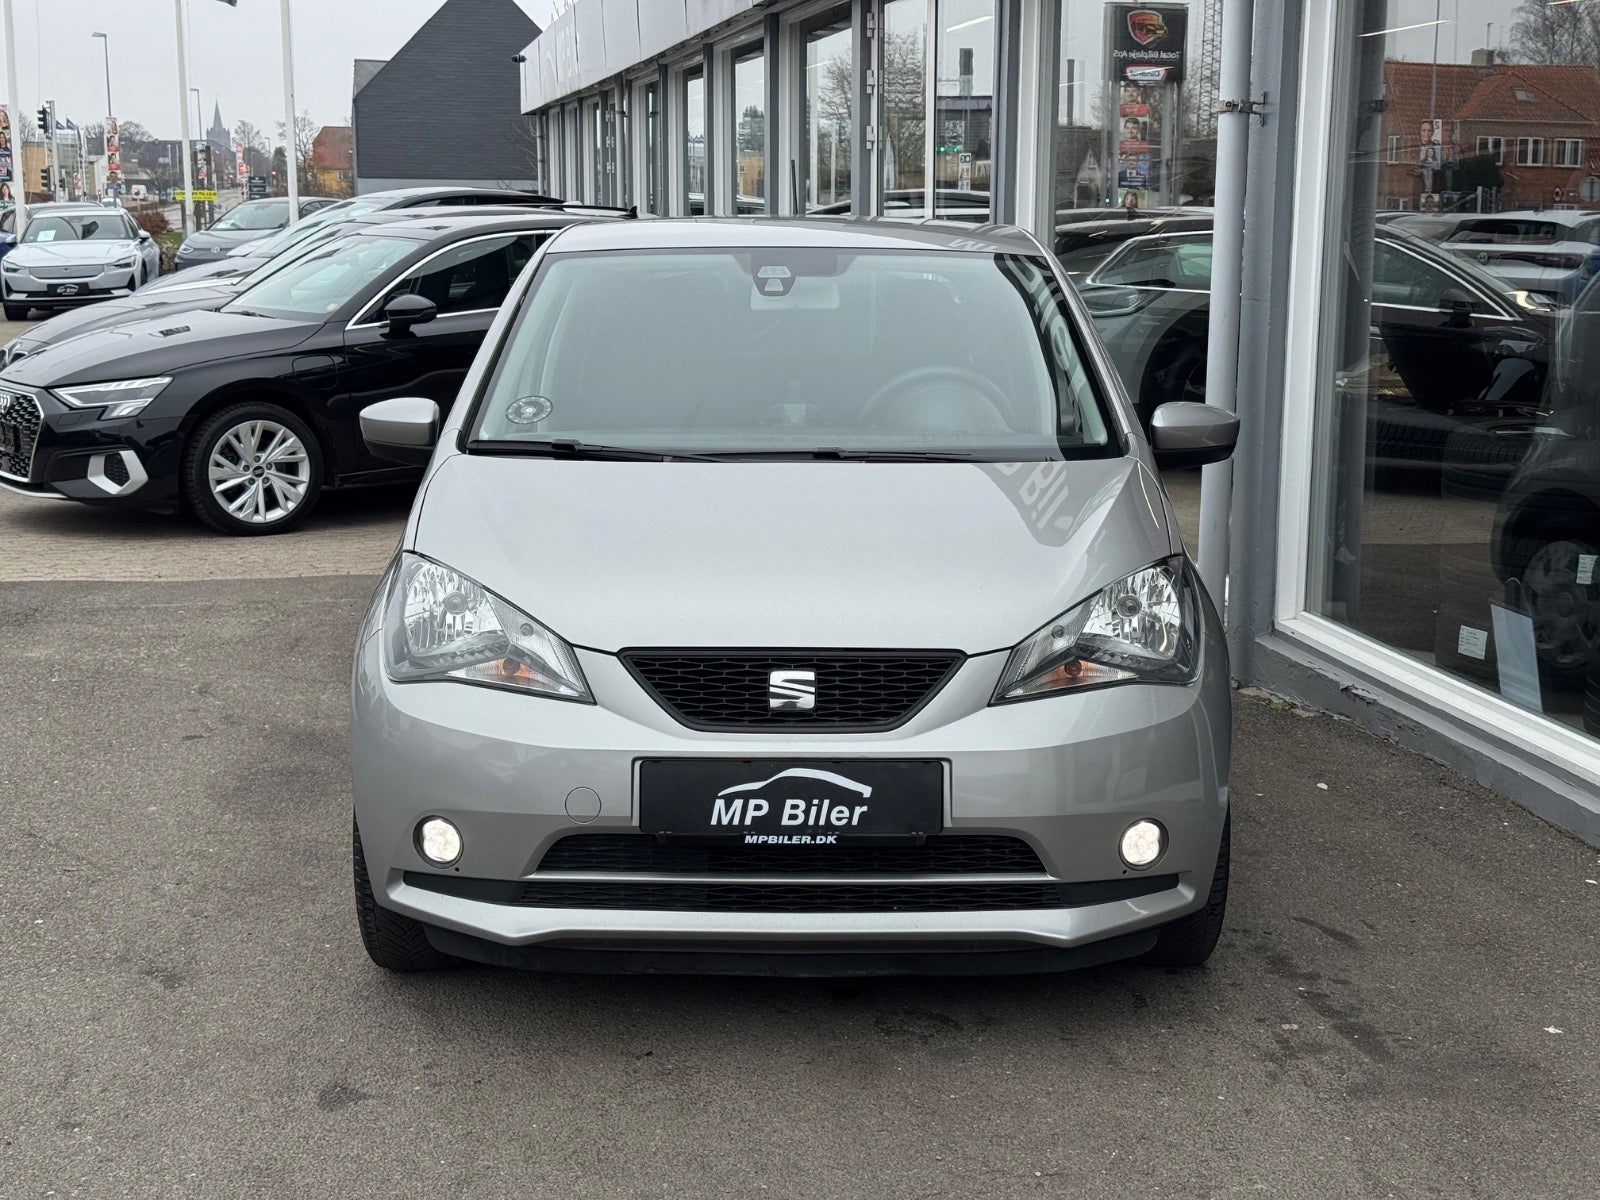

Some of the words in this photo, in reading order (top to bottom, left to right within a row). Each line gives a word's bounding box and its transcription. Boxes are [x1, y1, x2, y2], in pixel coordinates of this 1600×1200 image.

[710, 798, 769, 826] MP
[781, 798, 868, 826] Biler
[744, 835, 838, 844] MPBILER.DK
